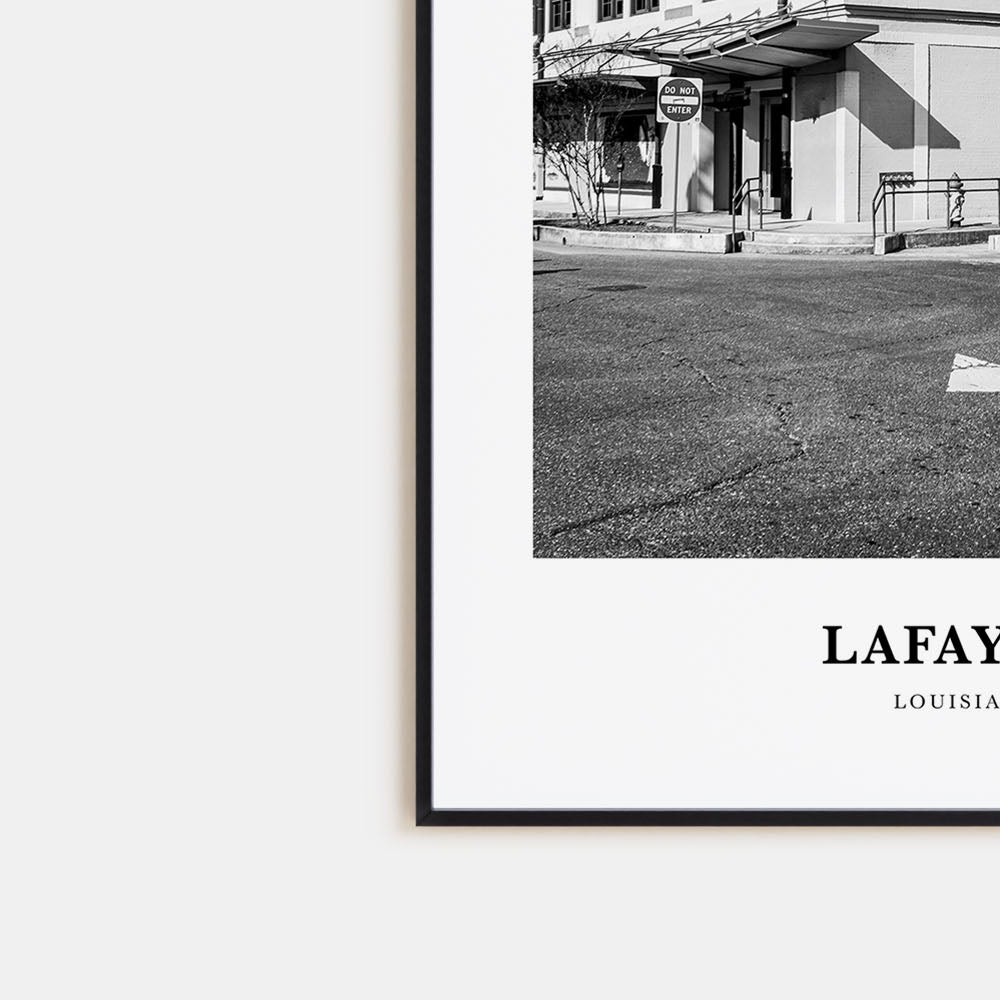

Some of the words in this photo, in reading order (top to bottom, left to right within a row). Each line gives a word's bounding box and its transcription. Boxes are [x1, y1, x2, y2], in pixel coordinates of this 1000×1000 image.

[664, 86, 676, 94] DO
[679, 87, 696, 95] NOT
[667, 105, 692, 114] ENTER
